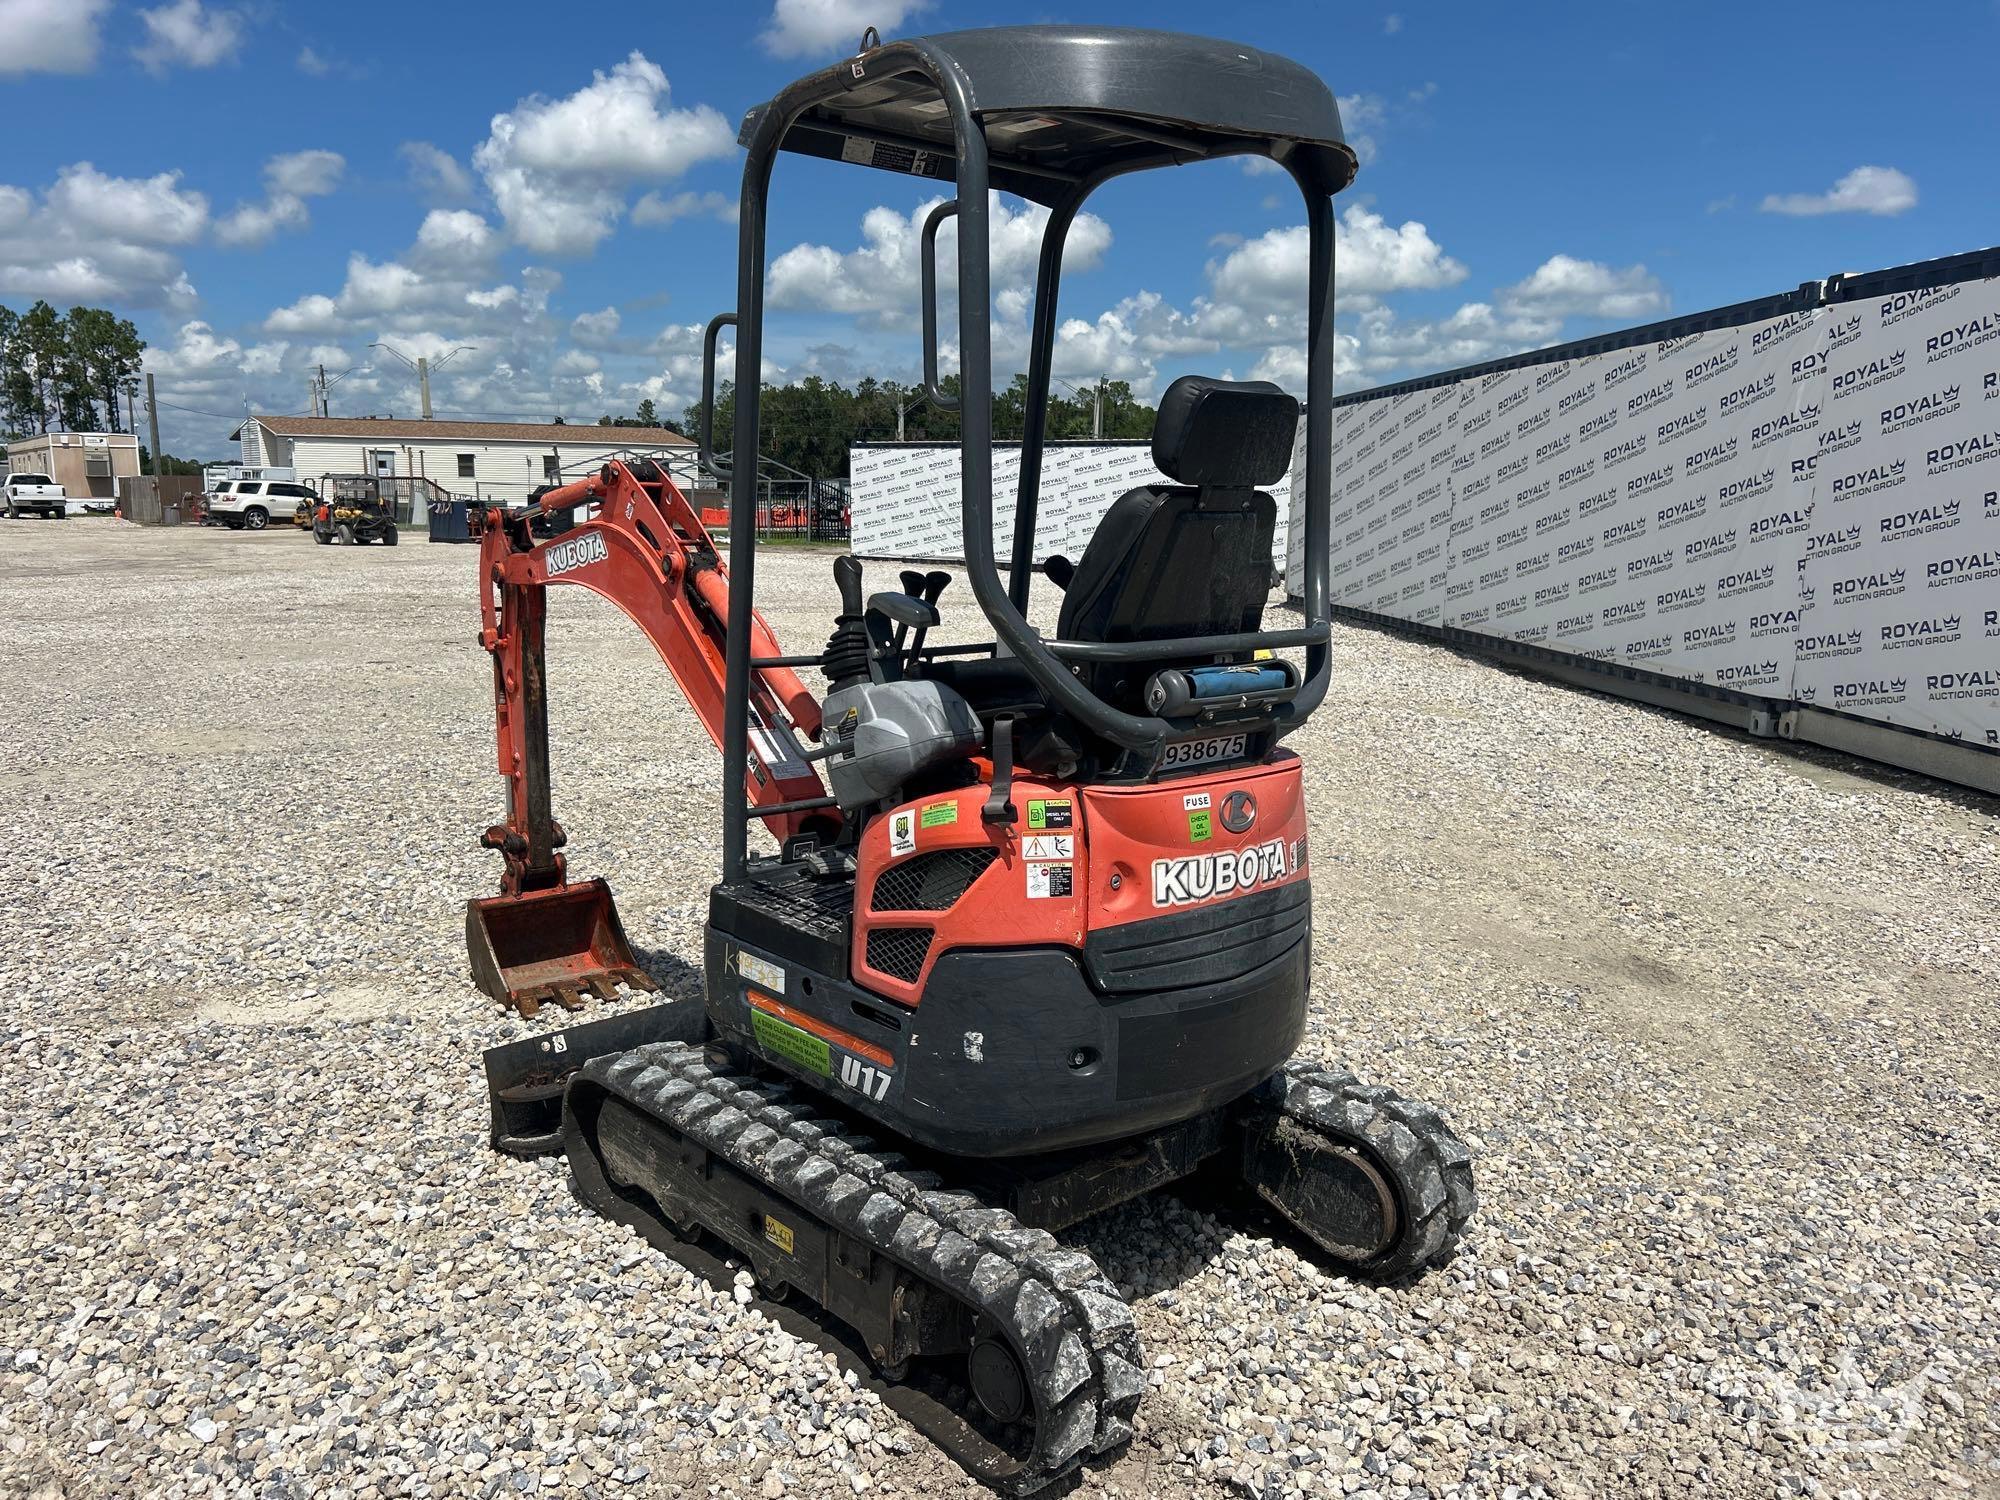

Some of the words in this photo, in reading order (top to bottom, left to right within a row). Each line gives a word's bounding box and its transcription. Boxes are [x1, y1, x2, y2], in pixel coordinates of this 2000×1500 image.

[1882, 304, 1923, 328] AUCTION
[1925, 288, 1960, 309] GROUP
[1753, 315, 1799, 347] ROYAL
[1753, 334, 1784, 356] AUCTION
[1785, 320, 1814, 339] GROUP
[1831, 331, 1861, 350] GROUP
[1927, 316, 1993, 353] ROYAL
[1927, 340, 1972, 364] AUCTION
[1604, 358, 1637, 384] ROYAL
[1686, 353, 1726, 382] ROYAL
[1686, 371, 1714, 390] AUCTION
[1714, 359, 1738, 376] GROUP
[1833, 358, 1889, 390] ROYAL
[1720, 380, 1763, 409] ROYAL
[1833, 380, 1871, 401] AUCTION
[1873, 367, 1906, 385] GROUP
[1498, 390, 1522, 410] ROYAL
[1559, 387, 1587, 410] ROYAL
[1628, 386, 1663, 411] ROYAL
[1721, 399, 1750, 418] AUCTION
[1750, 387, 1775, 404] GROUP
[1881, 393, 1942, 425] ROYAL
[1580, 413, 1609, 436] ROYAL
[1658, 413, 1696, 438] ROYAL
[1751, 412, 1799, 440] ROYAL
[1881, 415, 1923, 436] AUCTION
[1925, 403, 1960, 421] GROUP
[1658, 430, 1684, 446] AUCTION
[1685, 420, 1707, 434] GROUP
[1752, 431, 1783, 450] AUCTION
[1784, 420, 1818, 436] GROUP
[1481, 435, 1504, 453] ROYAL
[1536, 438, 1563, 458] ROYAL
[1603, 440, 1636, 462] ROYAL
[1832, 437, 1861, 453] GROUP
[1927, 434, 1994, 465] ROYAL
[1686, 444, 1726, 468] ROYAL
[1686, 461, 1713, 477] AUCTION
[1714, 451, 1737, 466] GROUP
[1927, 456, 1972, 476] AUCTION
[1498, 460, 1521, 478] ROYAL
[1559, 463, 1586, 484] ROYAL
[1833, 466, 1889, 493] ROYAL
[1628, 470, 1663, 492] ROYAL
[1720, 475, 1762, 500] ROYAL
[1833, 486, 1871, 503] AUCTION
[1873, 476, 1906, 492] GROUP
[1579, 492, 1608, 512] ROYAL
[1720, 493, 1748, 509] AUCTION
[1749, 484, 1774, 498] GROUP
[1481, 504, 1503, 518] ROYAL
[1658, 500, 1696, 522] ROYAL
[1658, 516, 1684, 530] AUCTION
[1684, 508, 1706, 521] GROUP
[1881, 506, 1942, 532] ROYAL
[1603, 521, 1636, 541] ROYAL
[1750, 511, 1803, 534] ROYAL
[1881, 527, 1923, 543] AUCTION
[1925, 518, 1960, 533] GROUP
[1497, 529, 1520, 545] ROYAL
[1686, 534, 1725, 556] ROYAL
[1750, 528, 1783, 544] AUCTION
[546, 532, 606, 575] KUBOTA
[1558, 539, 1586, 557] ROYAL
[1686, 550, 1712, 564] AUCTION
[1713, 544, 1736, 556] GROUP
[1832, 542, 1861, 555] GROUP
[1628, 554, 1663, 573] ROYAL
[1927, 552, 1994, 578] ROYAL
[1480, 569, 1502, 584] ROYAL
[1578, 570, 1608, 588] ROYAL
[1718, 569, 1761, 590] ROYAL
[1833, 573, 1889, 595] ROYAL
[1927, 573, 1973, 589] AUCTION
[1447, 582, 1467, 595] ROYAL
[1657, 587, 1695, 606] ROYAL
[1718, 586, 1748, 599] AUCTION
[1748, 580, 1774, 592] GROUP
[1833, 592, 1871, 606] AUCTION
[1873, 586, 1905, 598] GROUP
[1496, 597, 1520, 612] ROYAL
[1603, 602, 1636, 619] ROYAL
[1658, 603, 1683, 614] AUCTION
[1684, 598, 1706, 608] GROUP
[1557, 615, 1585, 631] ROYAL
[1750, 626, 1789, 638] AUCTION
[1881, 619, 1943, 640] ROYAL
[1684, 625, 1724, 643] ROYAL
[1685, 640, 1712, 651] AUCTION
[1713, 636, 1736, 646] GROUP
[1881, 638, 1923, 650] AUCTION
[1925, 633, 1961, 645] GROUP
[1626, 638, 1662, 654] ROYAL
[1832, 647, 1862, 657] GROUP
[1716, 664, 1760, 681] ROYAL
[1718, 680, 1747, 689] AUCTION
[1748, 676, 1779, 686] GROUP
[1927, 671, 1995, 690] ROYAL
[1834, 681, 1890, 698] ROYAL
[1928, 690, 1973, 701] AUCTION
[1835, 698, 1872, 707] AUCTION
[1874, 695, 1906, 705] GROUP
[1166, 736, 1244, 764] 938675
[1186, 796, 1208, 807] FUSE
[1191, 815, 1208, 823] CHECK
[1155, 840, 1287, 903] KUBOTA
[841, 1055, 891, 1101] U17
